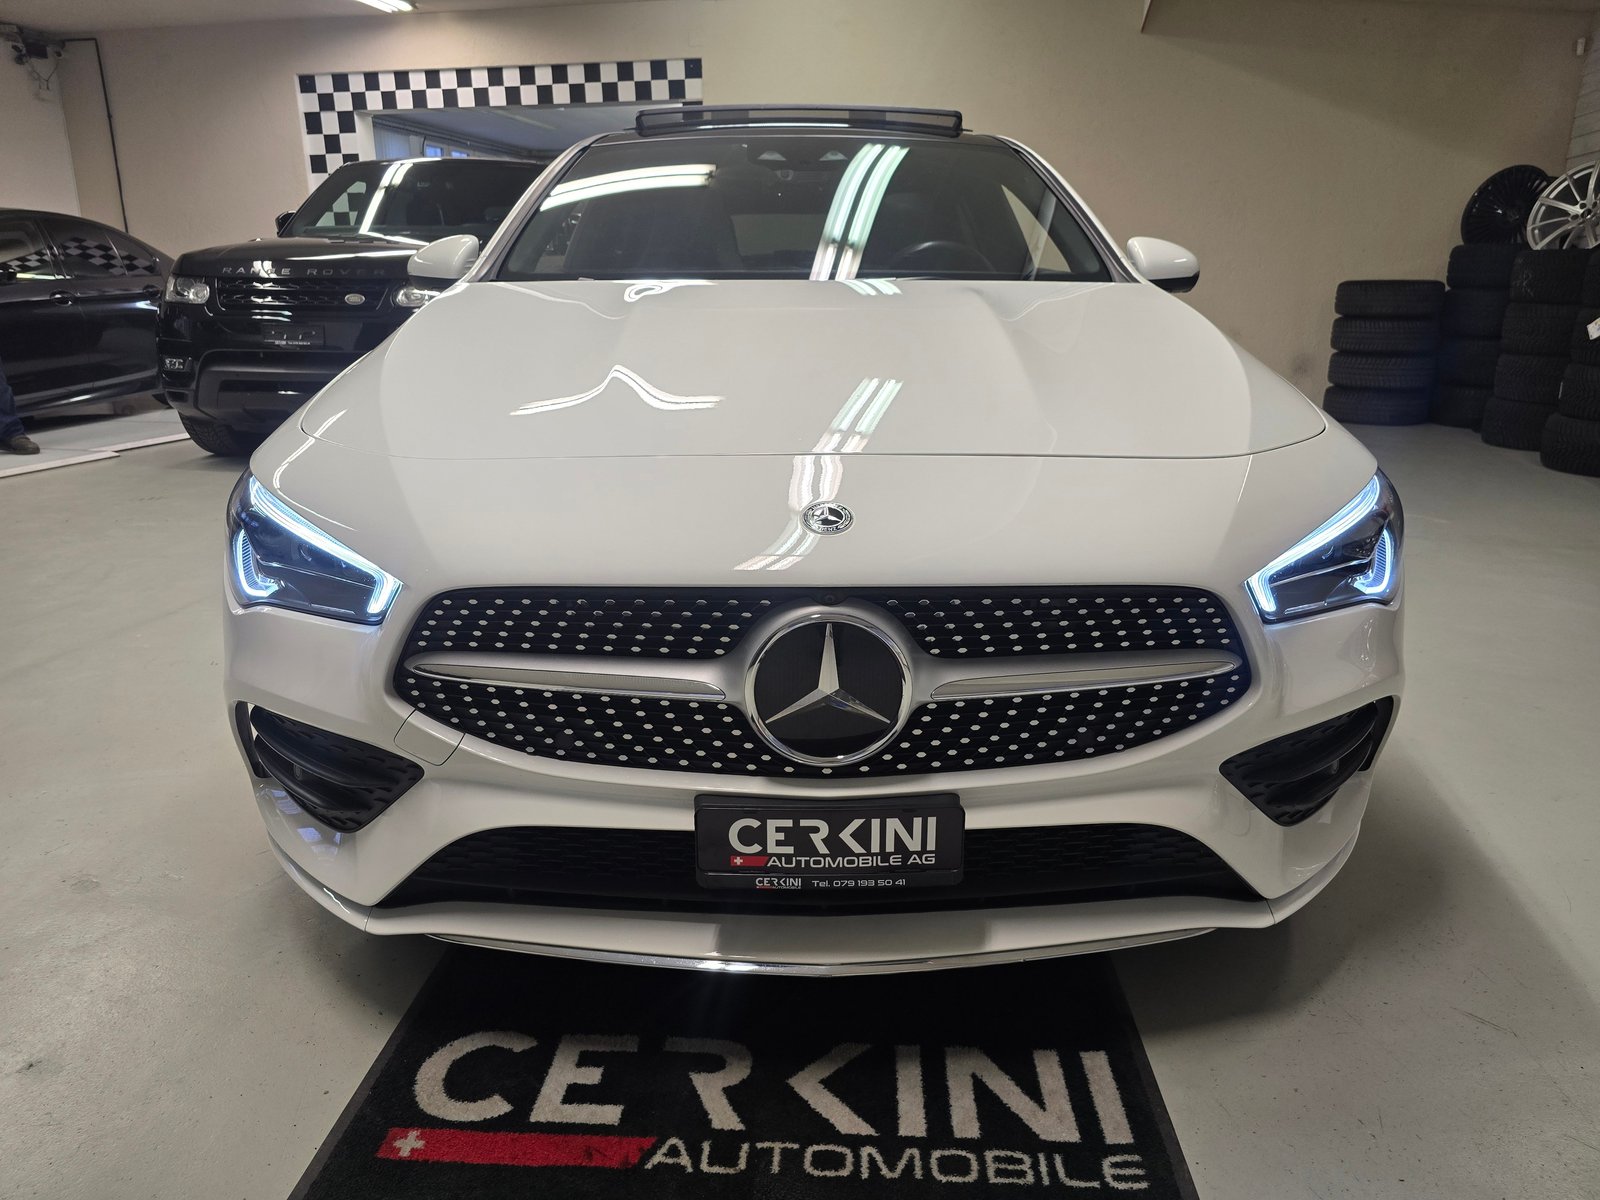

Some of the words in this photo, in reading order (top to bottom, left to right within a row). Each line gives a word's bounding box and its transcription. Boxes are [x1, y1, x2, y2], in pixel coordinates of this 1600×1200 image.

[728, 816, 937, 855] CERKINI
[766, 854, 902, 868] AUTOMOBILE
[907, 853, 936, 865] AG
[755, 877, 802, 887] CERKINI
[811, 880, 831, 888] Tel.
[857, 879, 875, 887] 193
[877, 879, 893, 887] 50
[895, 878, 906, 886] 41
[413, 1030, 1135, 1145] CERKINI
[644, 1136, 1151, 1191] AUTOMOBILE
